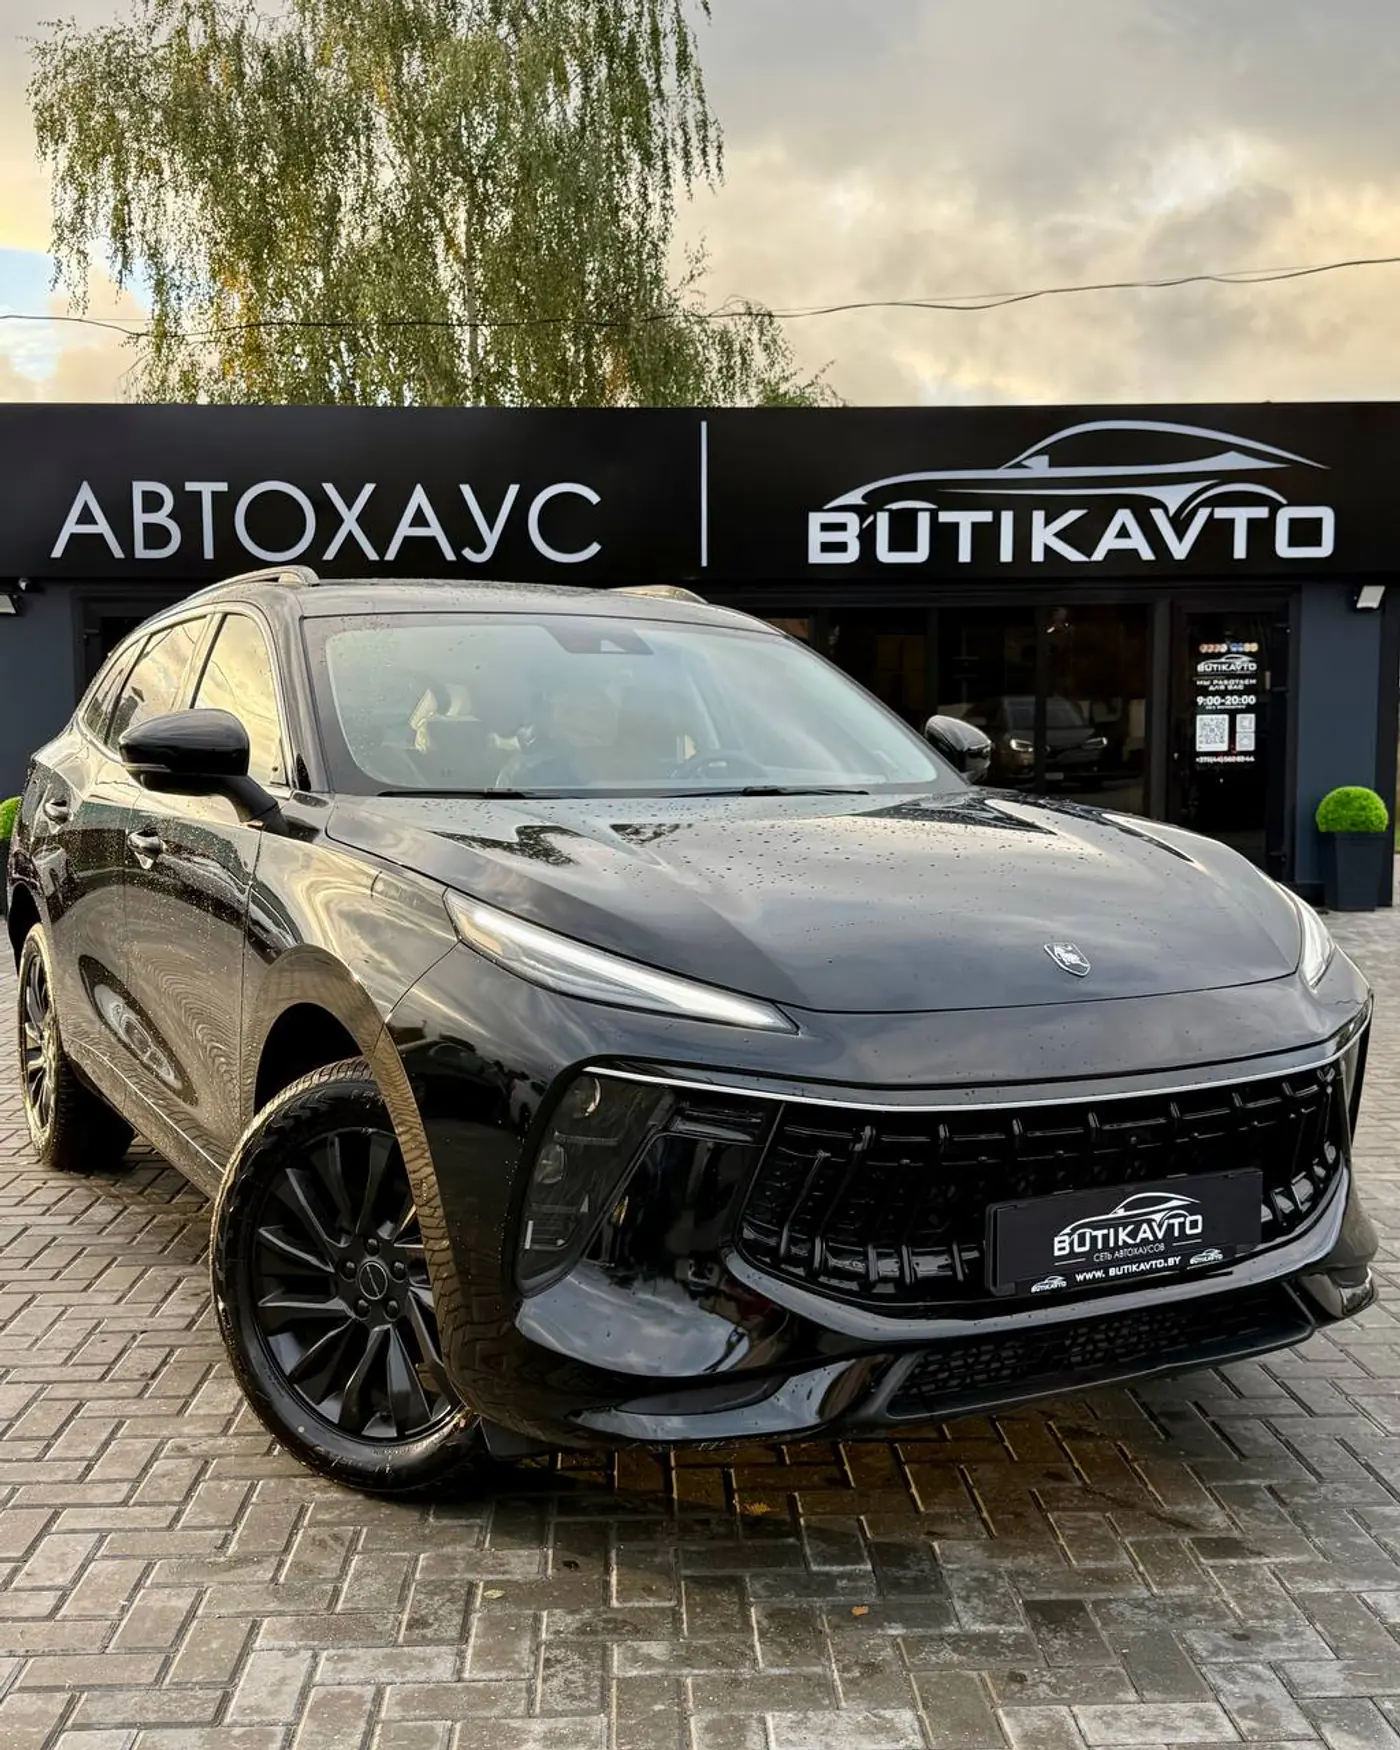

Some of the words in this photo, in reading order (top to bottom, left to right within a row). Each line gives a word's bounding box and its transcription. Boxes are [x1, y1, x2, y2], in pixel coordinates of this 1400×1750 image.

[50, 480, 602, 563] АВТОХАУС
[808, 506, 1334, 564] BUTIKAVTO
[1197, 662, 1257, 672] BUTIKAVTO
[1196, 695, 1257, 706] 9:00-20:00
[1053, 1214, 1203, 1256] BUTIKAVTO
[1093, 1251, 1112, 1262] СЕТЬ
[1113, 1242, 1165, 1259] АВТОХАУСОВ
